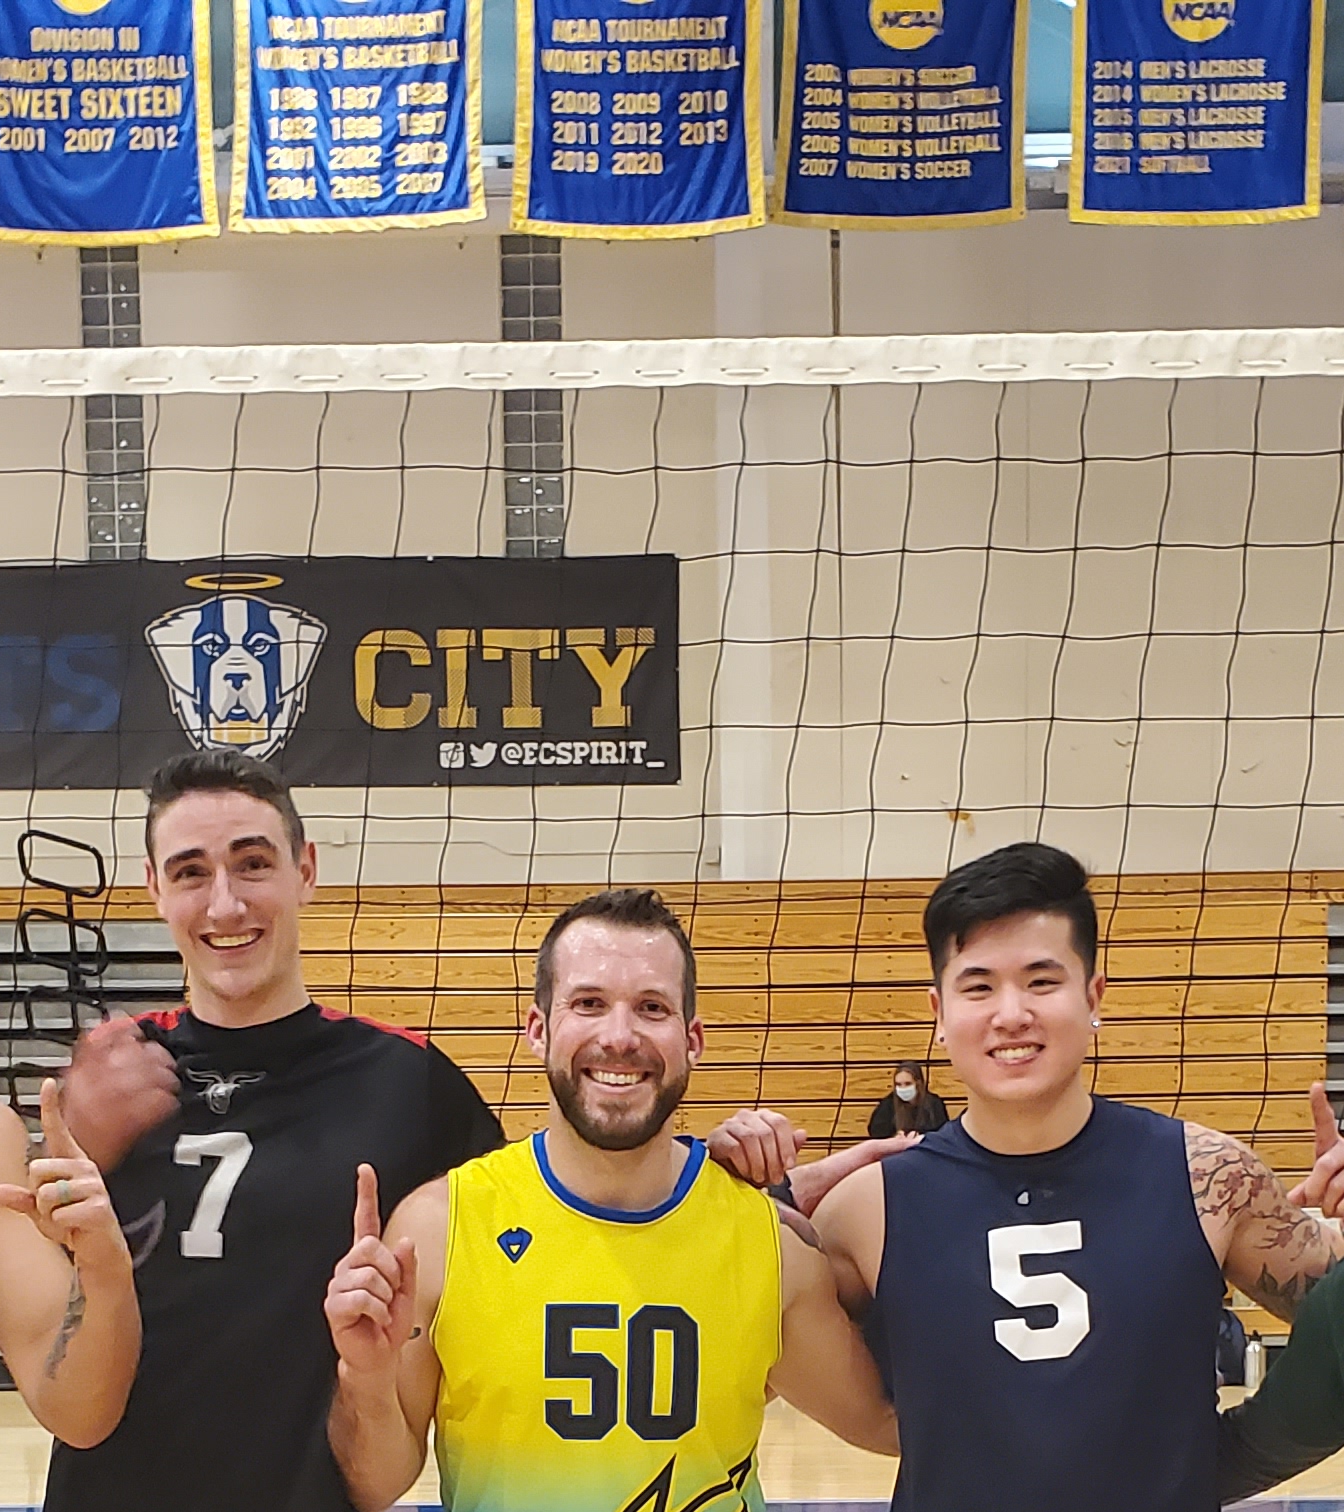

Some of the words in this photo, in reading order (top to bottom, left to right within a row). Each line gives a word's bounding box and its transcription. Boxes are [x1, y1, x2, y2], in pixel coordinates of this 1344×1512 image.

[1172, 2, 1234, 21] NCAA
[551, 18, 601, 43] NCAA
[605, 16, 728, 43] TOURNAMENT
[71, 55, 189, 82] BASKETBALL
[541, 49, 621, 74] WOMEN'S
[626, 46, 740, 74] BASKETBALL
[1188, 58, 1266, 79] LACROSSE
[80, 85, 182, 120] SIXTEEN
[551, 90, 601, 115] 2008
[612, 92, 661, 115] 2009
[678, 90, 728, 115] 2010
[803, 87, 844, 107] 2004
[849, 114, 913, 134] WOMEN'S
[916, 109, 1001, 133] VOLLEYBALL
[1187, 106, 1266, 126] LACROSSE
[64, 127, 116, 152] 2007
[128, 125, 178, 151] 2012
[552, 120, 599, 145] 2011
[611, 121, 663, 145] 2012
[679, 119, 728, 146] 2013
[848, 137, 912, 157] WOMEN'S
[915, 133, 1001, 157] VOLLEYBALL
[551, 150, 599, 173] 2019
[611, 151, 663, 175] 2020
[799, 158, 839, 177] 2007
[846, 160, 911, 180] WOMEN'S
[914, 159, 972, 179] SOCCER
[354, 627, 655, 729] CITY
[173, 1131, 254, 1258] 7
[988, 1220, 1090, 1361] 5
[544, 1303, 699, 1441] 50
